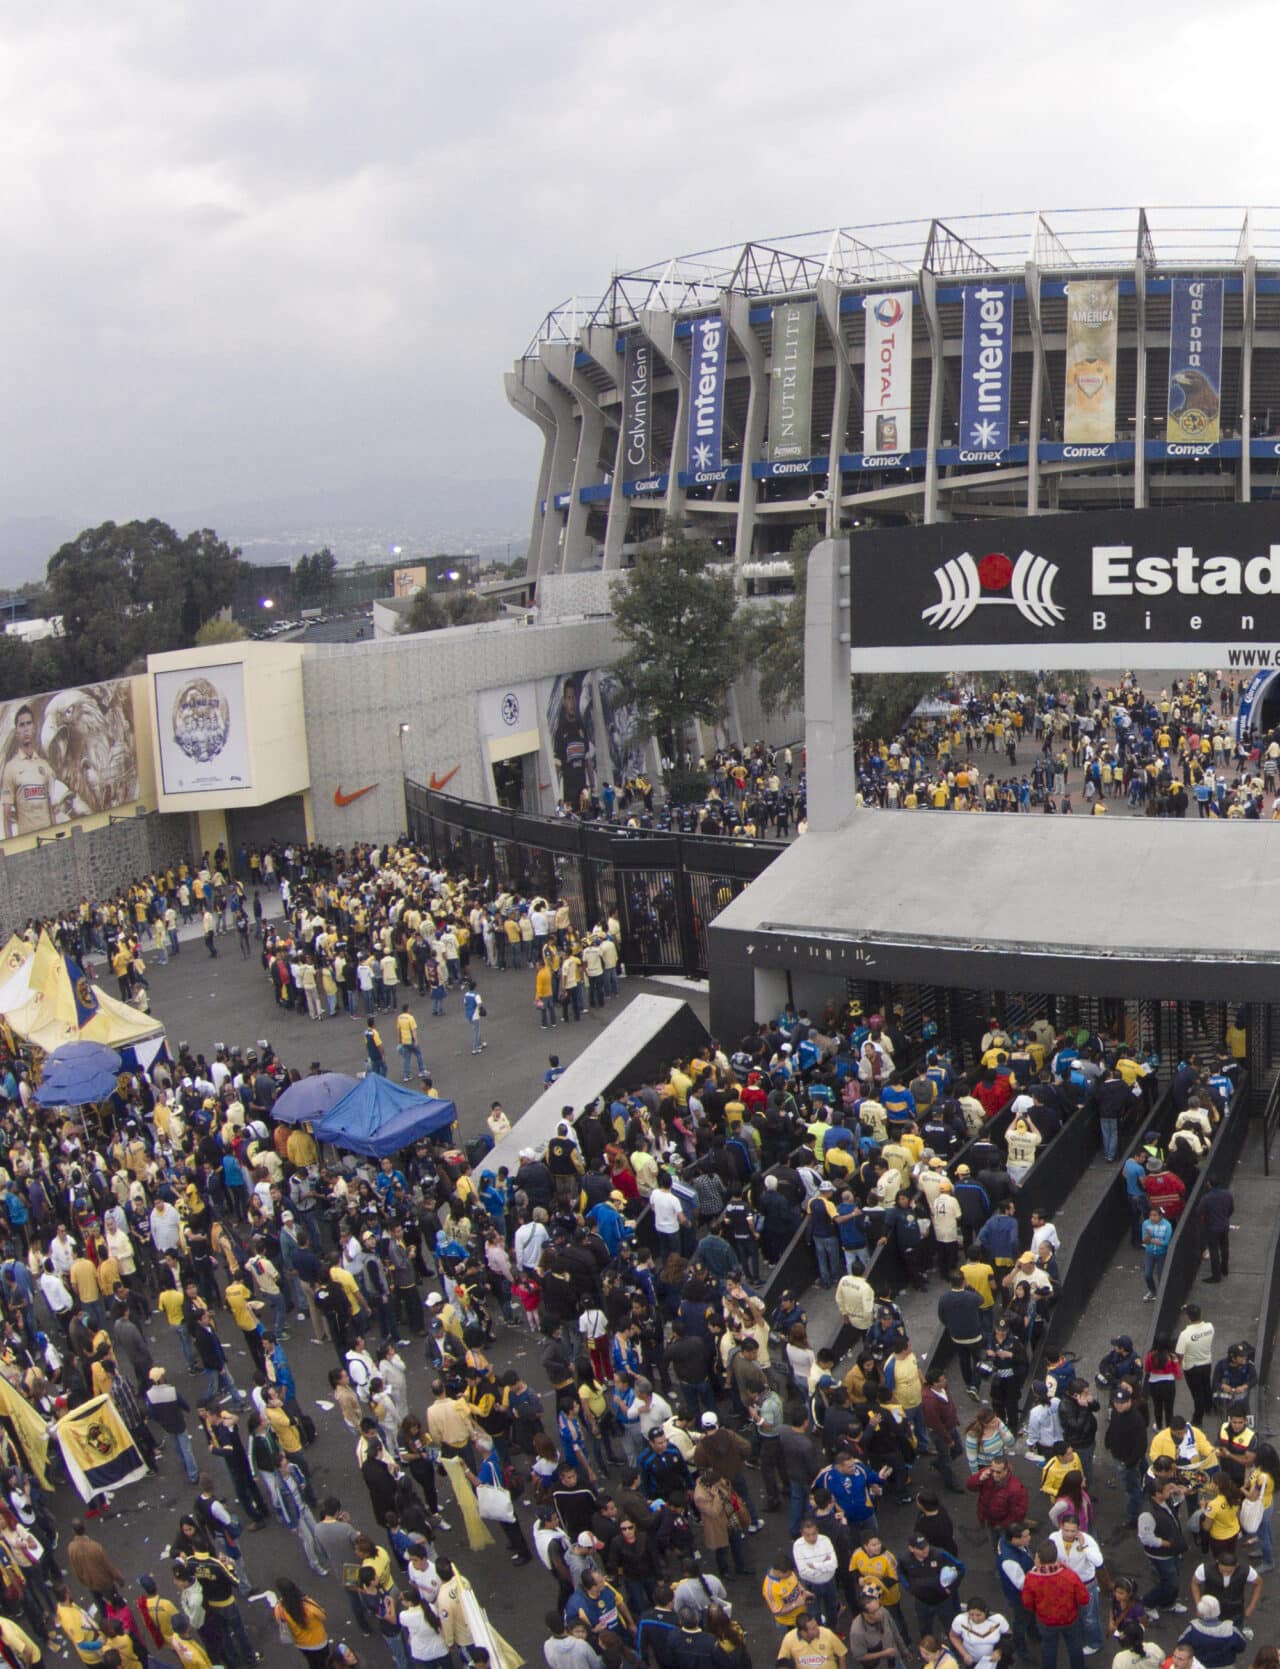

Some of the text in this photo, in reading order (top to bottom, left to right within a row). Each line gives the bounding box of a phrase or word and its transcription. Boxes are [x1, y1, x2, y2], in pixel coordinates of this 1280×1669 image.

[1188, 282, 1205, 367] Corona
[782, 309, 801, 437] NUTRILITE
[880, 333, 896, 408] TOTAL
[628, 347, 647, 465] Calvin Klein
[959, 449, 1005, 462] Comex
[1063, 444, 1110, 458] Comex
[1167, 442, 1214, 456] Comex
[772, 460, 811, 474] Comex
[862, 454, 904, 467] Comex
[695, 470, 729, 482] Comex
[635, 478, 661, 491] Comex
